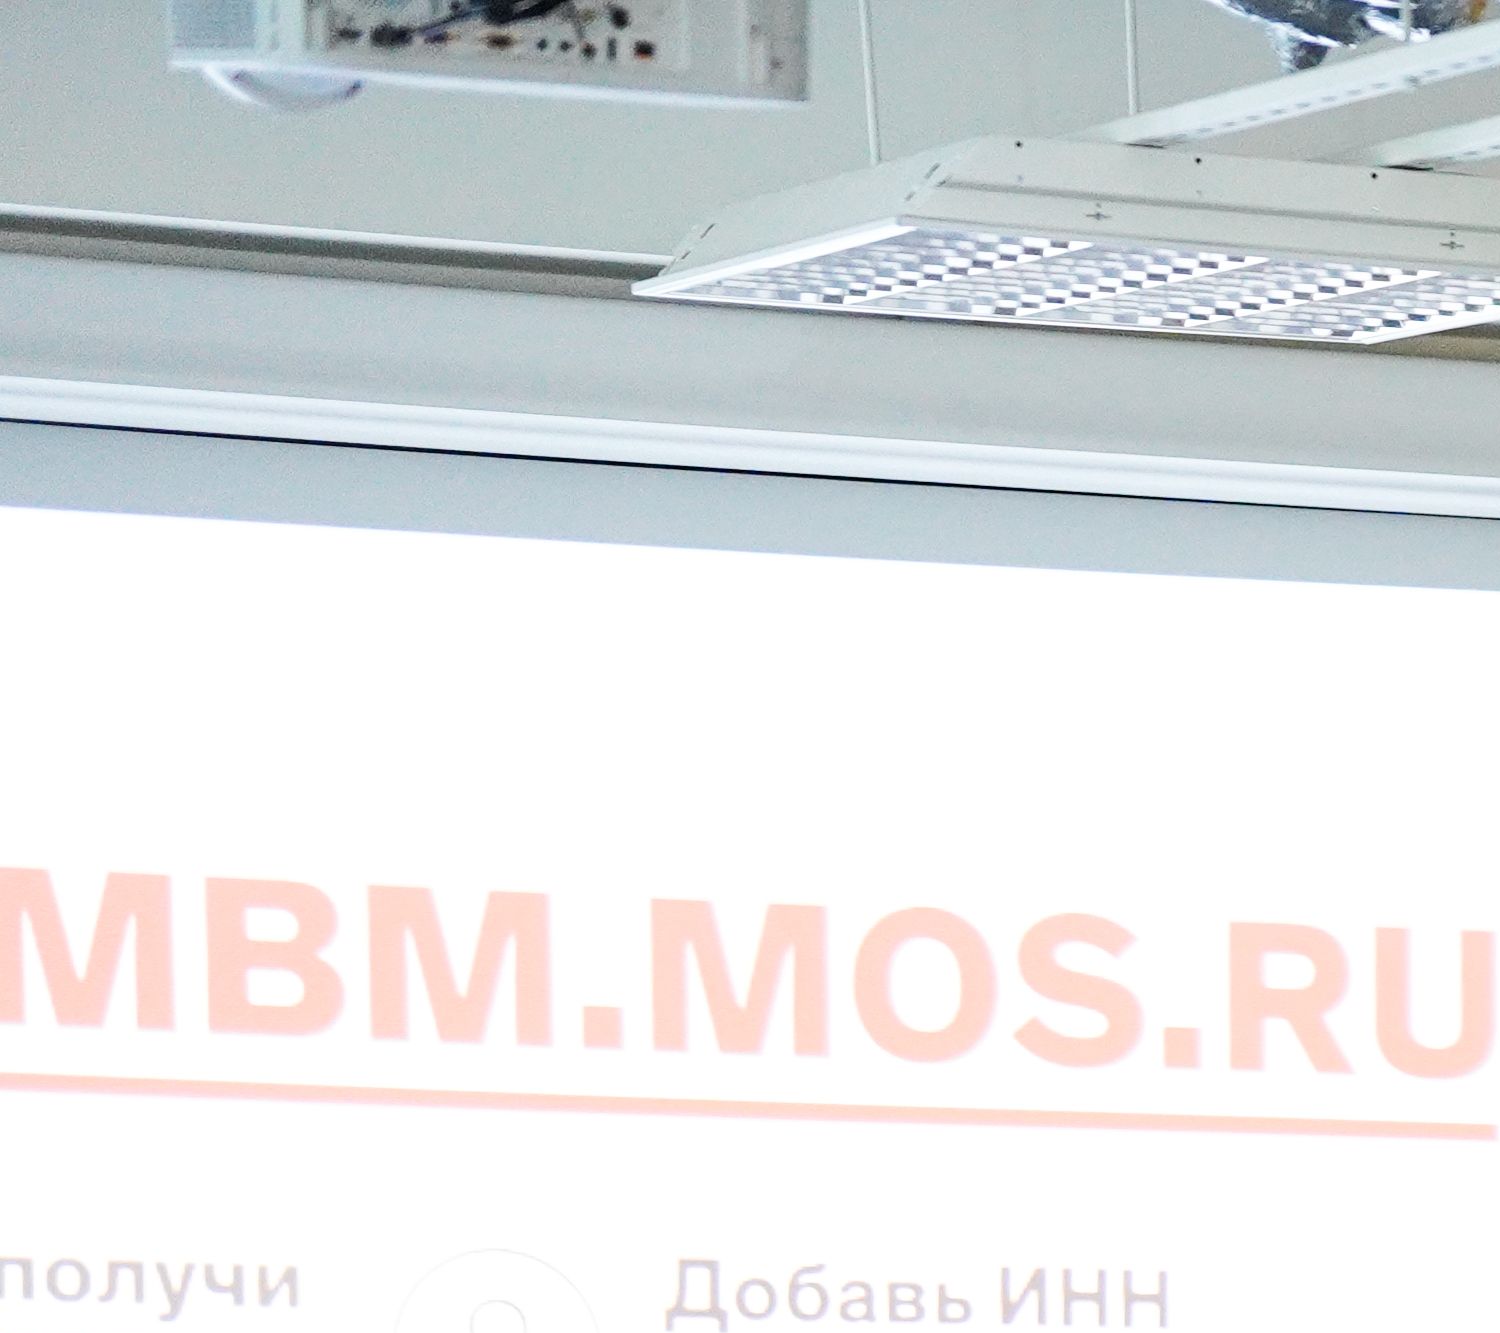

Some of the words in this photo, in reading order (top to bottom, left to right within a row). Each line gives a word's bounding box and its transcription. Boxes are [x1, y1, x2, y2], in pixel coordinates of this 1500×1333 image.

[0, 866, 1499, 1081] MBM.MOS.RU
[0, 1257, 299, 1323] получи
[664, 1258, 973, 1333] Добавь
[1000, 1266, 1169, 1329] ИНН
